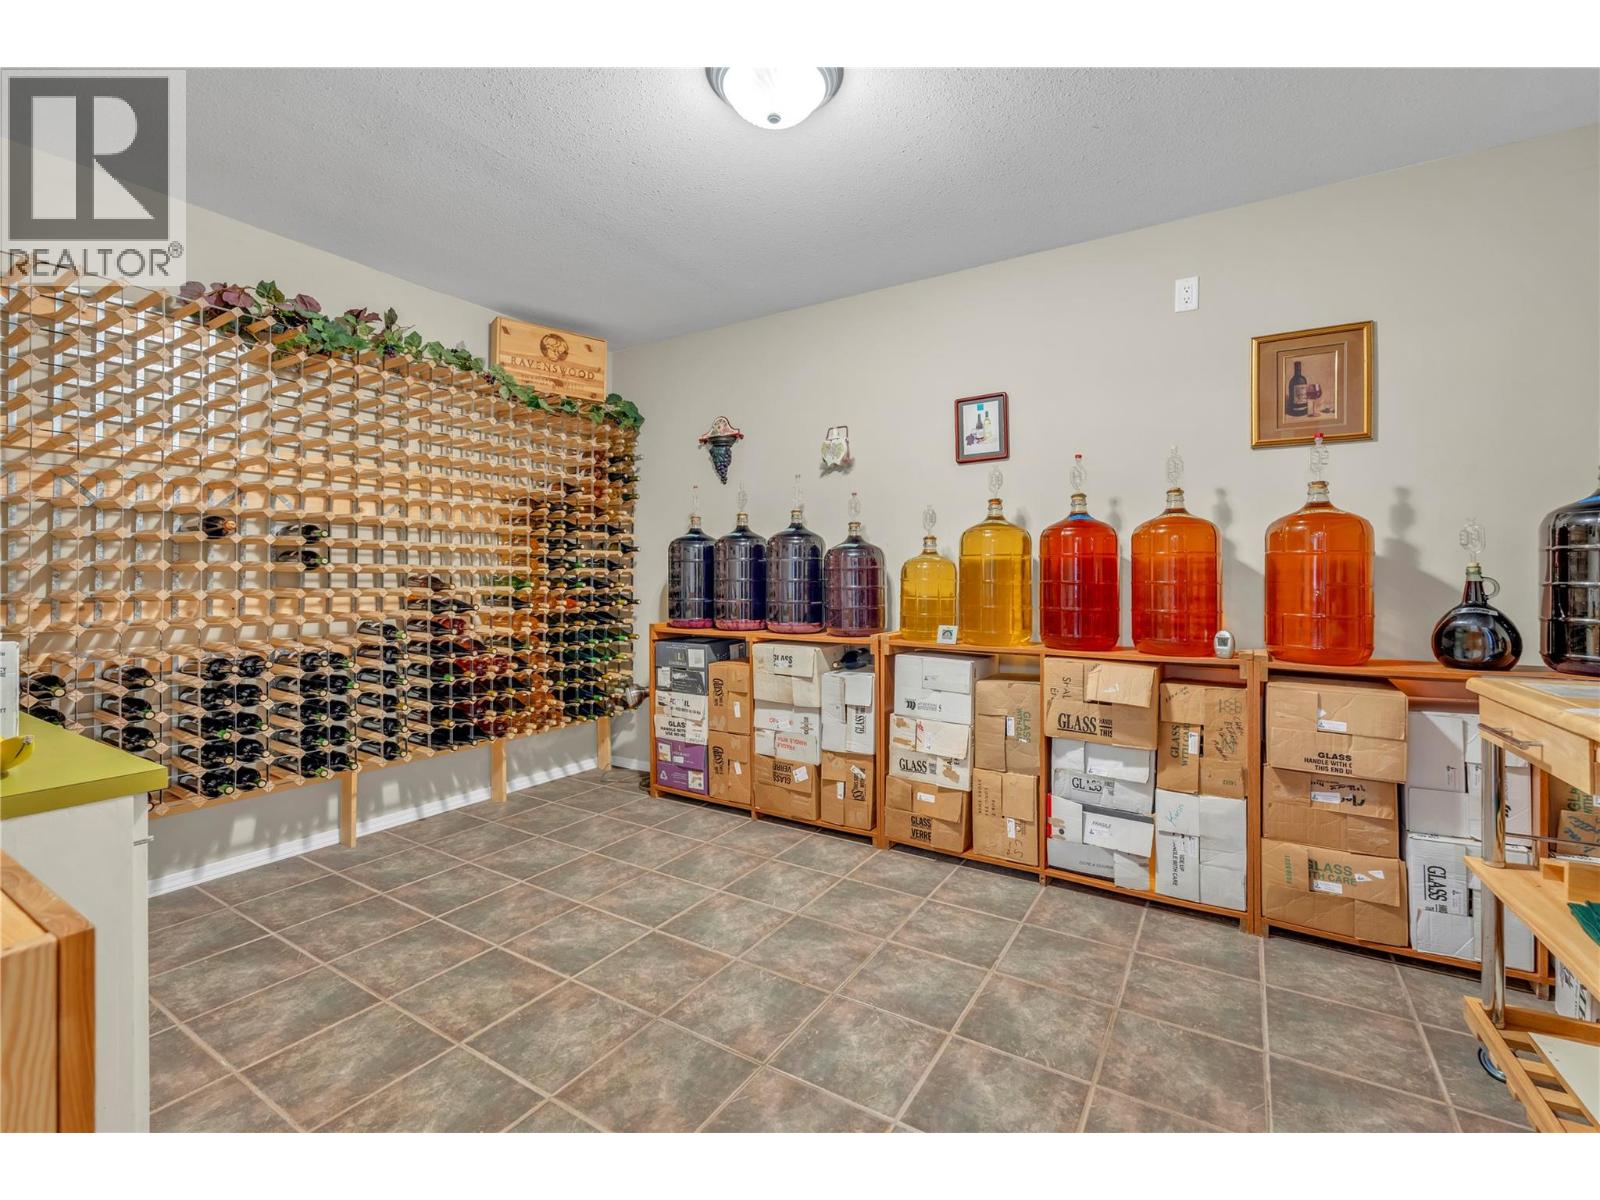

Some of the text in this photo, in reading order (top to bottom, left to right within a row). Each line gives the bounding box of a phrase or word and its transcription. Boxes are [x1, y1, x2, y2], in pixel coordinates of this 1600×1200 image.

[511, 356, 595, 381] RAVENSWOOD
[1057, 712, 1097, 733] GLASS
[1170, 724, 1180, 758] GLASS
[1304, 757, 1329, 766] HANDLE
[1331, 760, 1348, 768] WITH
[1318, 752, 1352, 761] GLASS
[899, 757, 928, 773] GLASS
[911, 815, 932, 829] GLASS
[911, 828, 932, 843] VERRE
[1328, 874, 1358, 887] CARE
[1427, 865, 1447, 902] GLASS
